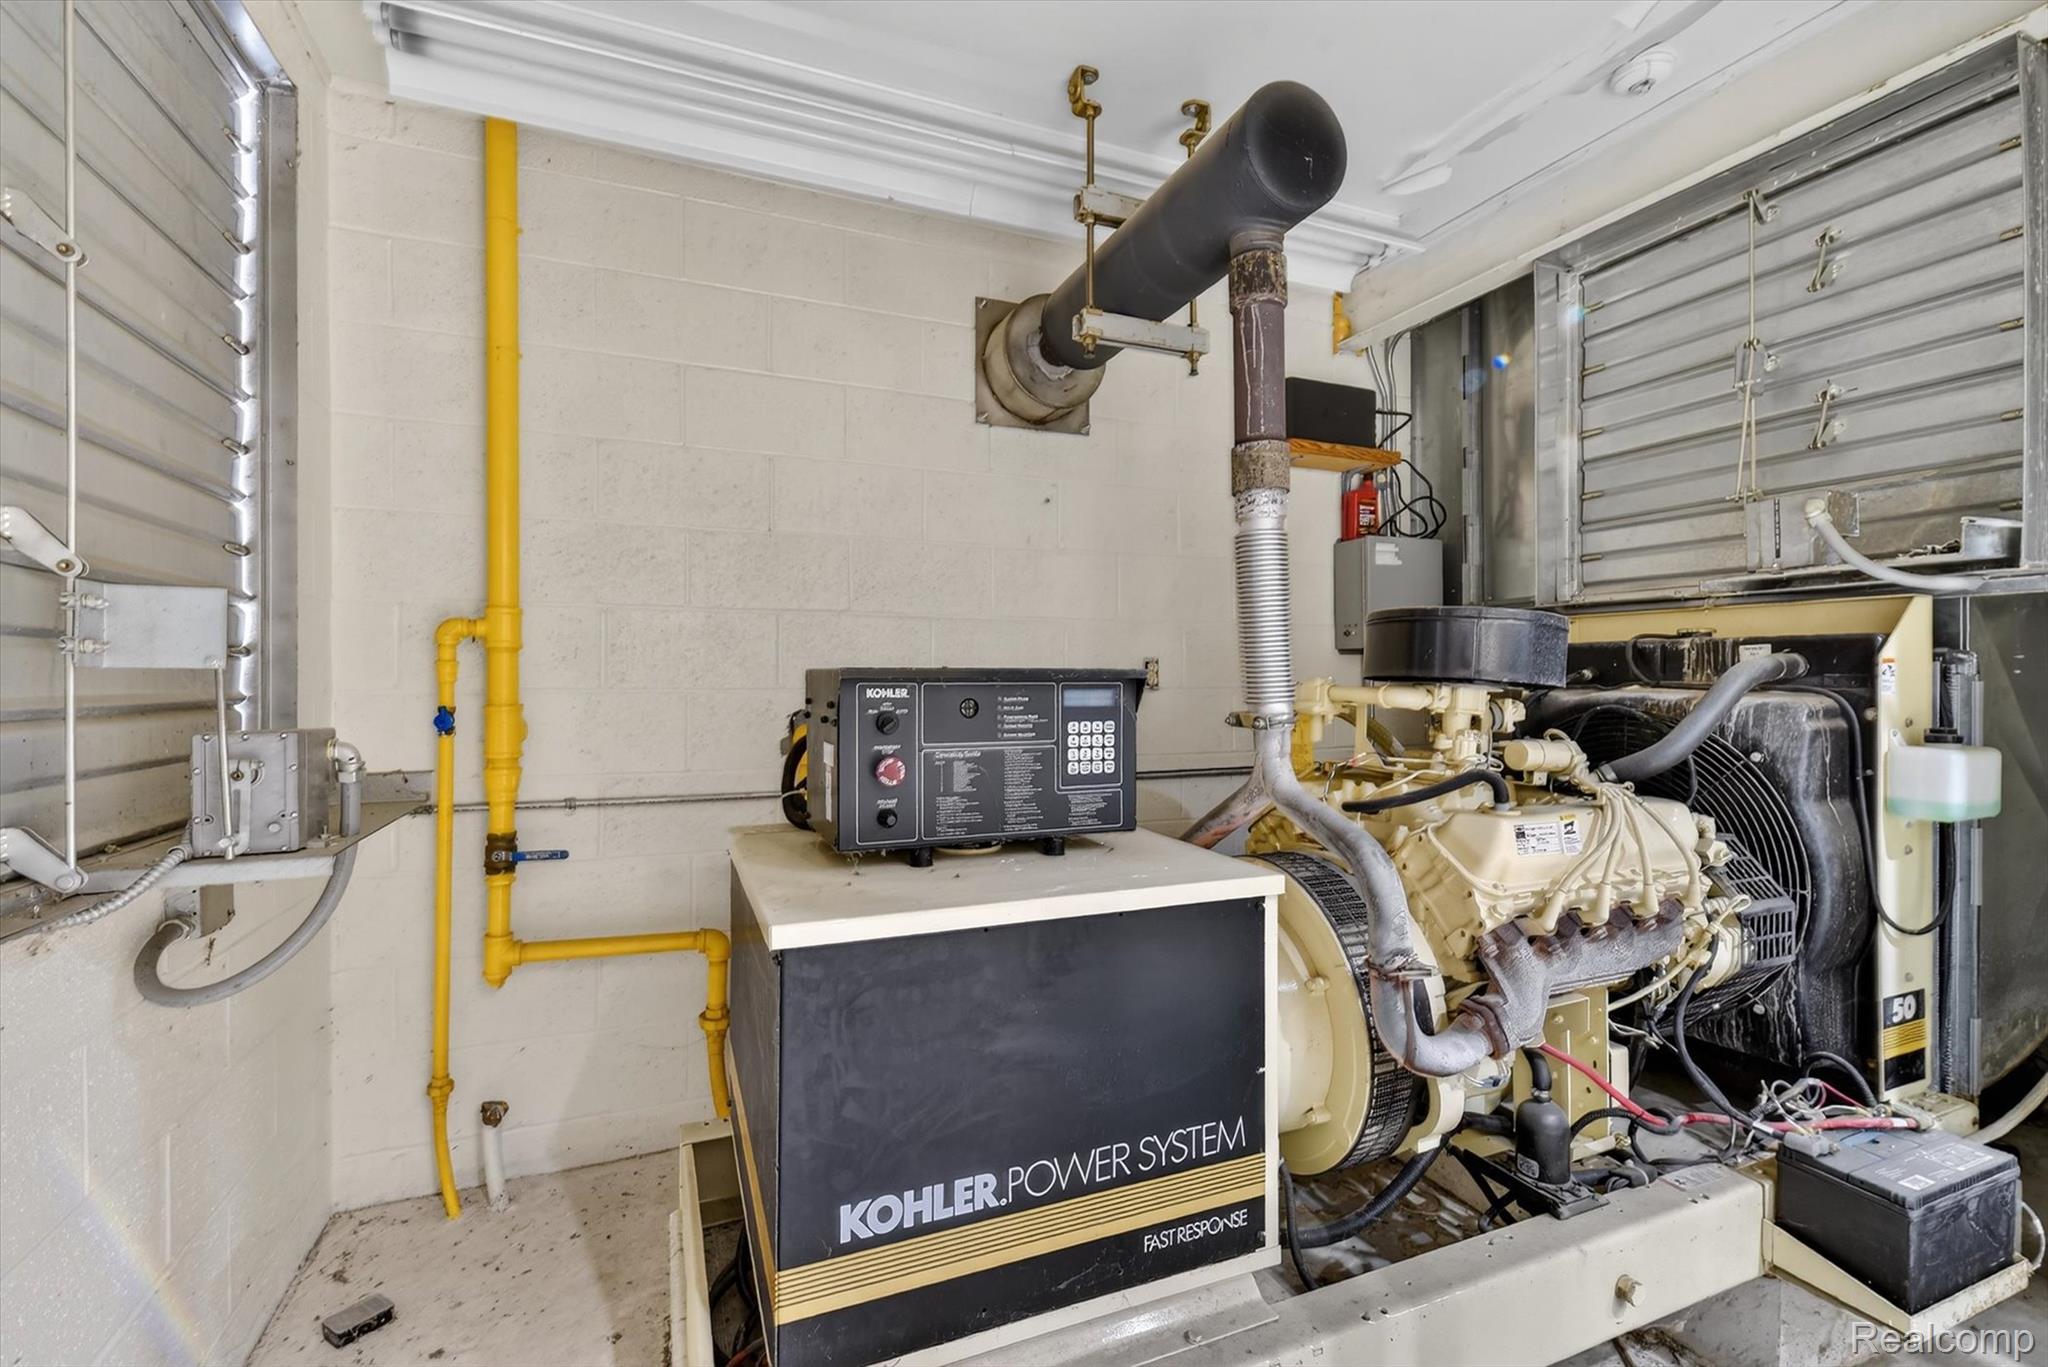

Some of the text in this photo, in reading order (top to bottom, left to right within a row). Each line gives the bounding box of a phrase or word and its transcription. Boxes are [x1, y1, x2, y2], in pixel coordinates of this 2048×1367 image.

[1892, 994, 1915, 1023] 50
[1008, 1142, 1131, 1204] POWER
[1138, 1115, 1246, 1171] SYSTEM
[1143, 1209, 1248, 1253] FAST RESPONSE
